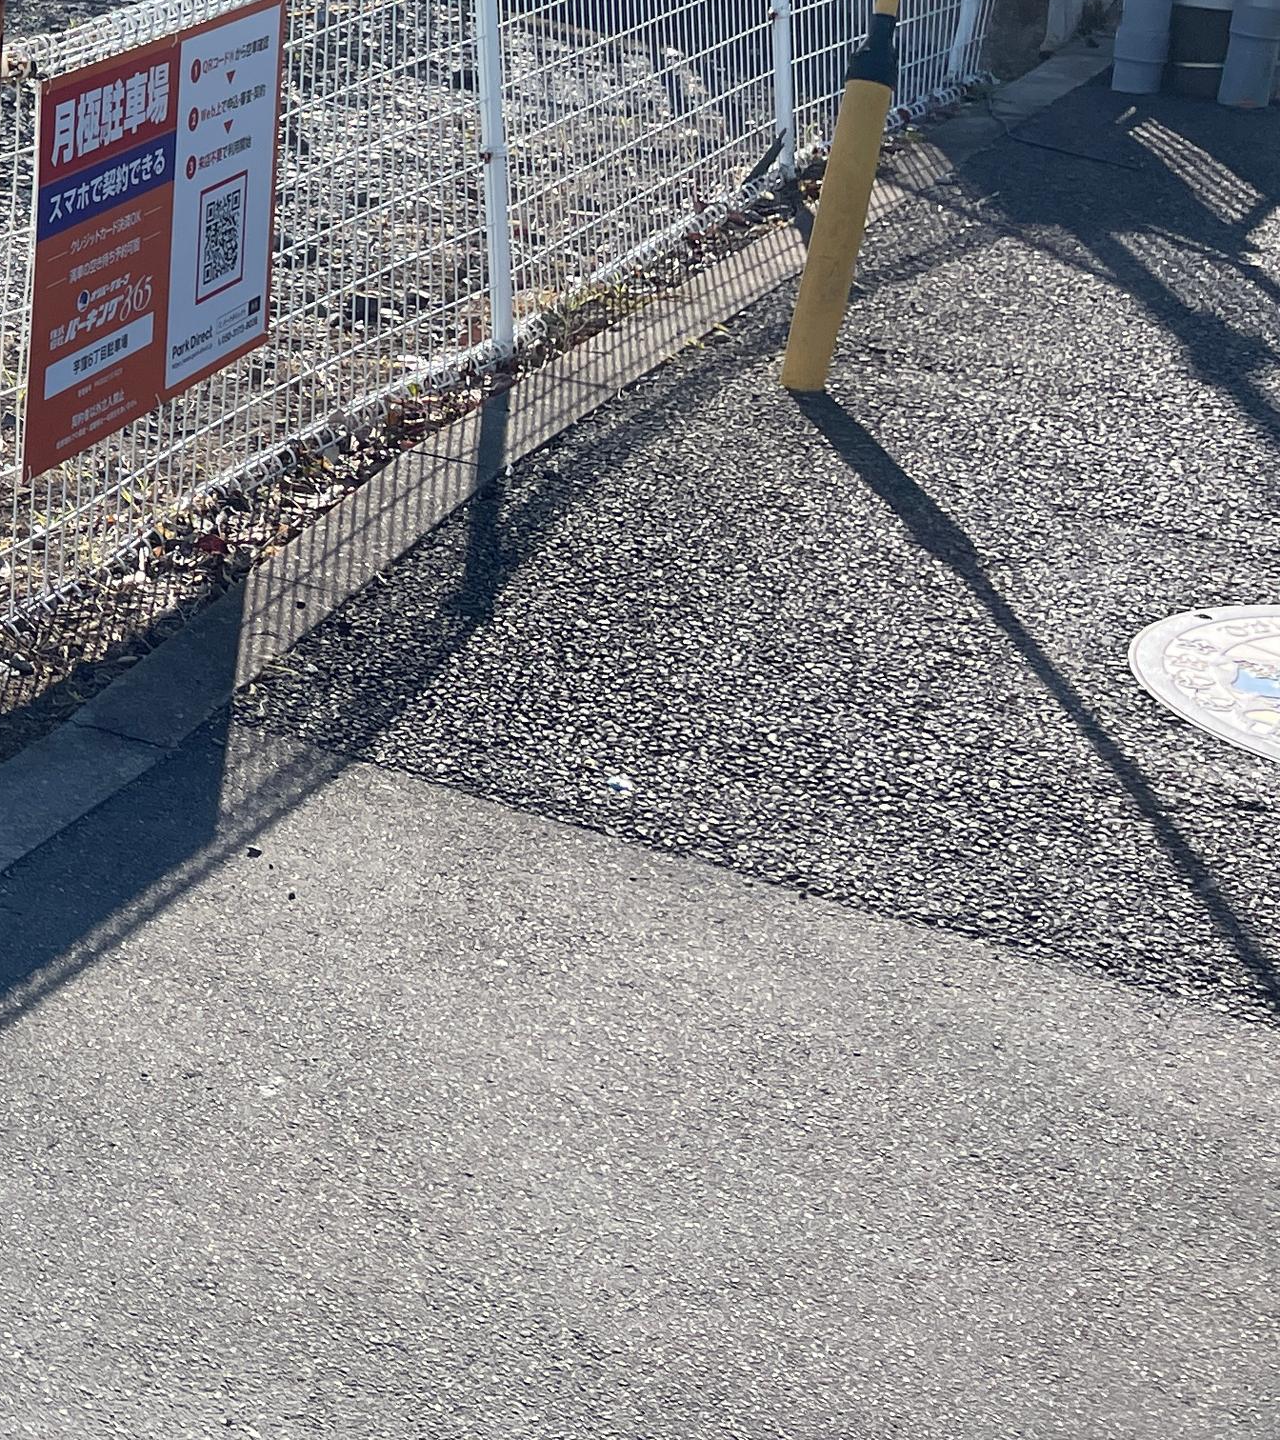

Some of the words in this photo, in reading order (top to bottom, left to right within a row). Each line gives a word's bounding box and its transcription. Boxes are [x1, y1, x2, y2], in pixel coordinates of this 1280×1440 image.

[51, 62, 170, 167] 月極駐車場
[48, 148, 165, 223] スマホで契約できる
[172, 338, 190, 359] Park
[190, 325, 213, 349] Direct
